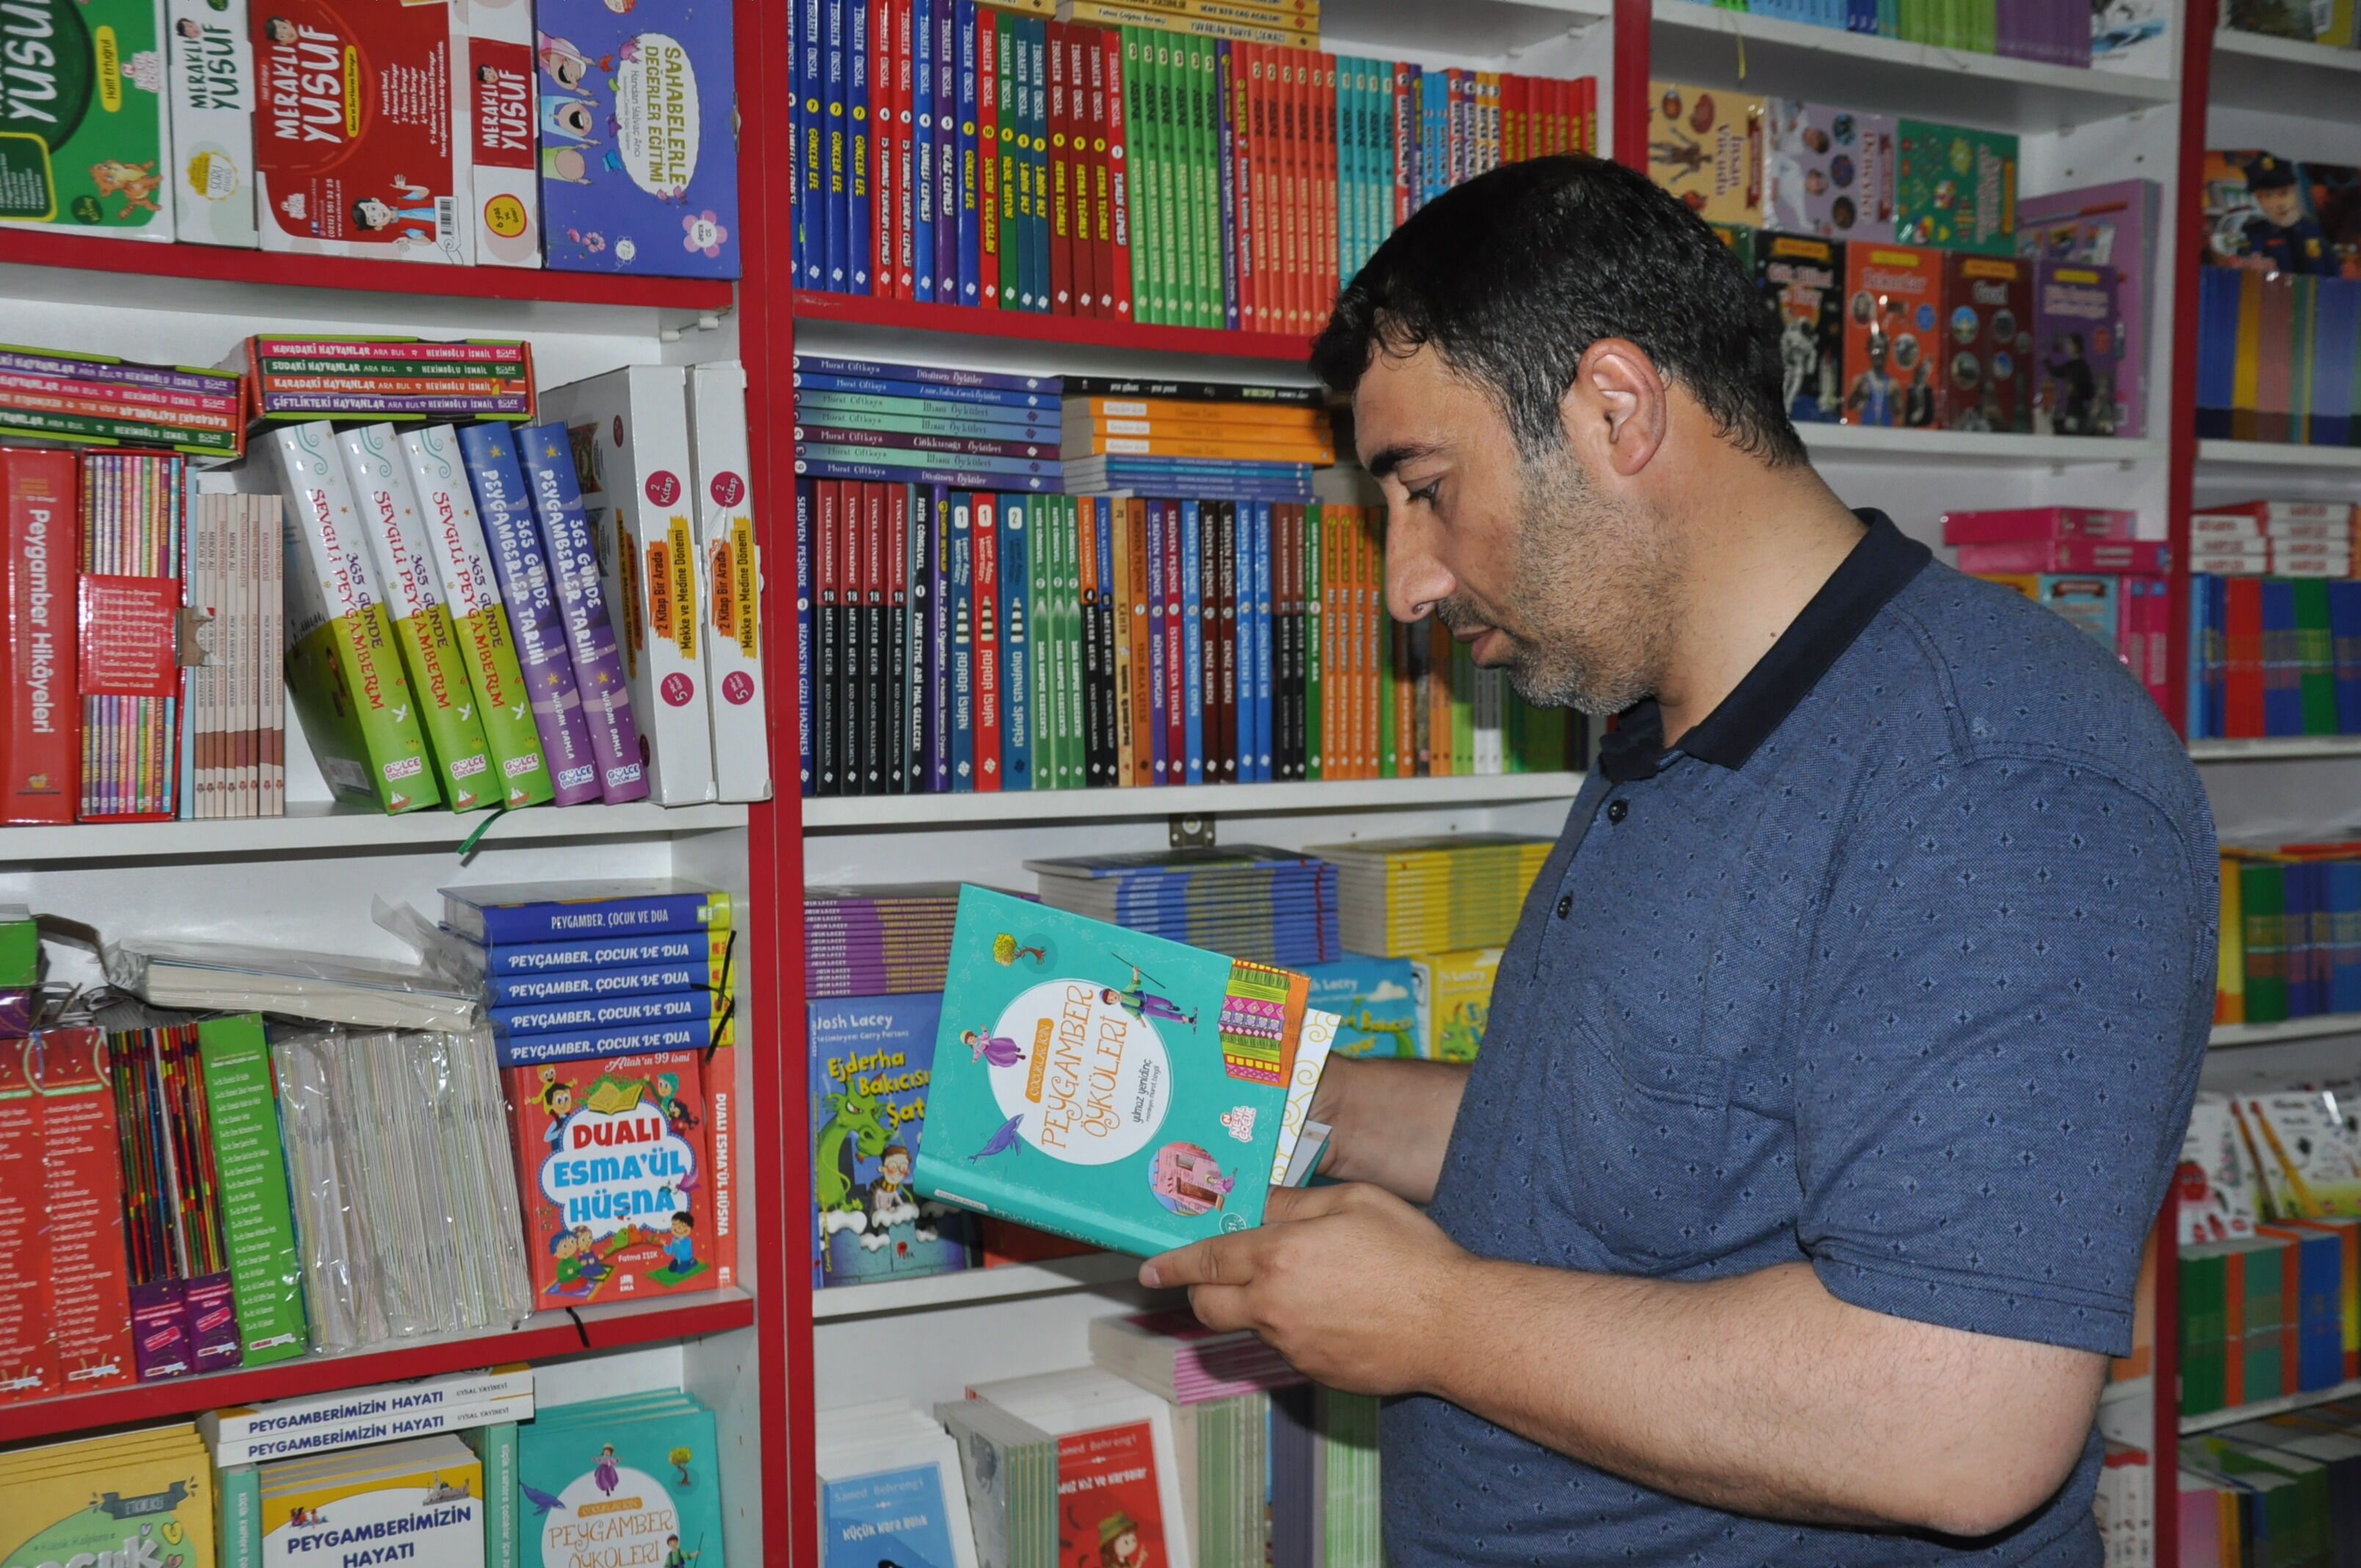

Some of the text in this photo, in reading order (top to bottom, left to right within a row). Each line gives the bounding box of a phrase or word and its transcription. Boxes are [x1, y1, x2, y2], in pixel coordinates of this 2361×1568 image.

[0, 0, 58, 123] YUSU
[183, 40, 209, 109] MERAKLI
[202, 23, 241, 110] YUSUF
[297, 23, 343, 144] YUSUF
[105, 78, 118, 100] Halit
[271, 46, 300, 140] MERAKLI
[498, 68, 528, 150] YUSUF
[481, 84, 499, 148] MERAKLI
[645, 46, 667, 183] DEĞERLER EĞİTİMİ
[664, 46, 687, 185] SAHABELERLE
[272, 343, 316, 355] HAVADAKİ
[319, 344, 371, 357] HAYVANLAR
[468, 347, 492, 359] İSMAİL
[272, 360, 360, 373] SUDAKİ HAYVANLAR
[333, 396, 385, 410] HAYVANLAR
[659, 476, 675, 504] Kitap
[482, 469, 530, 605] PEYGAMBERLER
[538, 469, 582, 604] PEYGAMBERLER
[797, 496, 806, 542] SERÜVEN
[515, 518, 551, 609] 365 GÜNDE
[569, 518, 602, 609] 365 GÜNDE
[653, 551, 664, 573] Arada
[654, 576, 665, 594] Bir
[797, 545, 807, 588] PEŞİNDE
[346, 552, 385, 650] 365 GÜNDE
[410, 553, 450, 649] 365 GÜNDE
[468, 553, 504, 649] 365 GÜNDE
[655, 600, 670, 623] Kitap
[671, 529, 692, 650] Mekke ve Medine Dönemi
[735, 529, 753, 649] Mekke ve Medine Dönemi
[824, 590, 835, 602] 18
[23, 508, 56, 733] Peygamber Hikâyeleri
[799, 678, 809, 705] GİZLİ
[981, 649, 995, 727] ADADA İSYAN
[551, 691, 576, 760] NURDAN DAMLA
[799, 708, 809, 756] HAZİNESİ
[607, 912, 637, 929] ÇOCUK
[637, 910, 650, 923] VE
[650, 909, 669, 923] DUA
[595, 946, 639, 964] ÇOCUK
[640, 945, 659, 959] VE
[661, 943, 689, 957] DUA
[595, 974, 639, 992] ÇOCUK
[640, 973, 660, 987] VE
[661, 971, 690, 984] DUA
[598, 1004, 642, 1022] ÇOCUK
[642, 1003, 662, 1017] VE
[664, 1001, 692, 1015] DUA
[816, 1014, 893, 1032] Josh Lacey
[596, 1034, 641, 1052] ÇOCUK
[642, 1033, 661, 1047] VE
[662, 1030, 691, 1044] DUA
[654, 1052, 670, 1065] 99
[671, 1051, 690, 1063] ismi
[827, 1048, 906, 1084] Ejderha
[1029, 1045, 1048, 1097] ÇOCUKLAR
[1041, 984, 1095, 1149] PEYGAMBER
[1080, 1015, 1128, 1139] ÖYKÜLERİ
[716, 1092, 728, 1131] DUALI
[1132, 1059, 1153, 1124] yılmaz yenidinç
[572, 1117, 661, 1150] DUALI
[553, 1146, 686, 1188] ESMA'ÜL
[716, 1190, 729, 1237] HÜSNA
[617, 1252, 642, 1263] Fatma
[248, 1398, 387, 1434] PEYGAMBERİMİZİN
[391, 1391, 444, 1411] HAYATI
[455, 1387, 478, 1396] UYSAL
[248, 1415, 445, 1458] PEYGAMBERİMİZİN HAYATI
[286, 1505, 472, 1556] PEYGAMBERİMİZİN
[547, 1509, 675, 1553] PEYGAMBER
[342, 1542, 416, 1568] HAYATI
